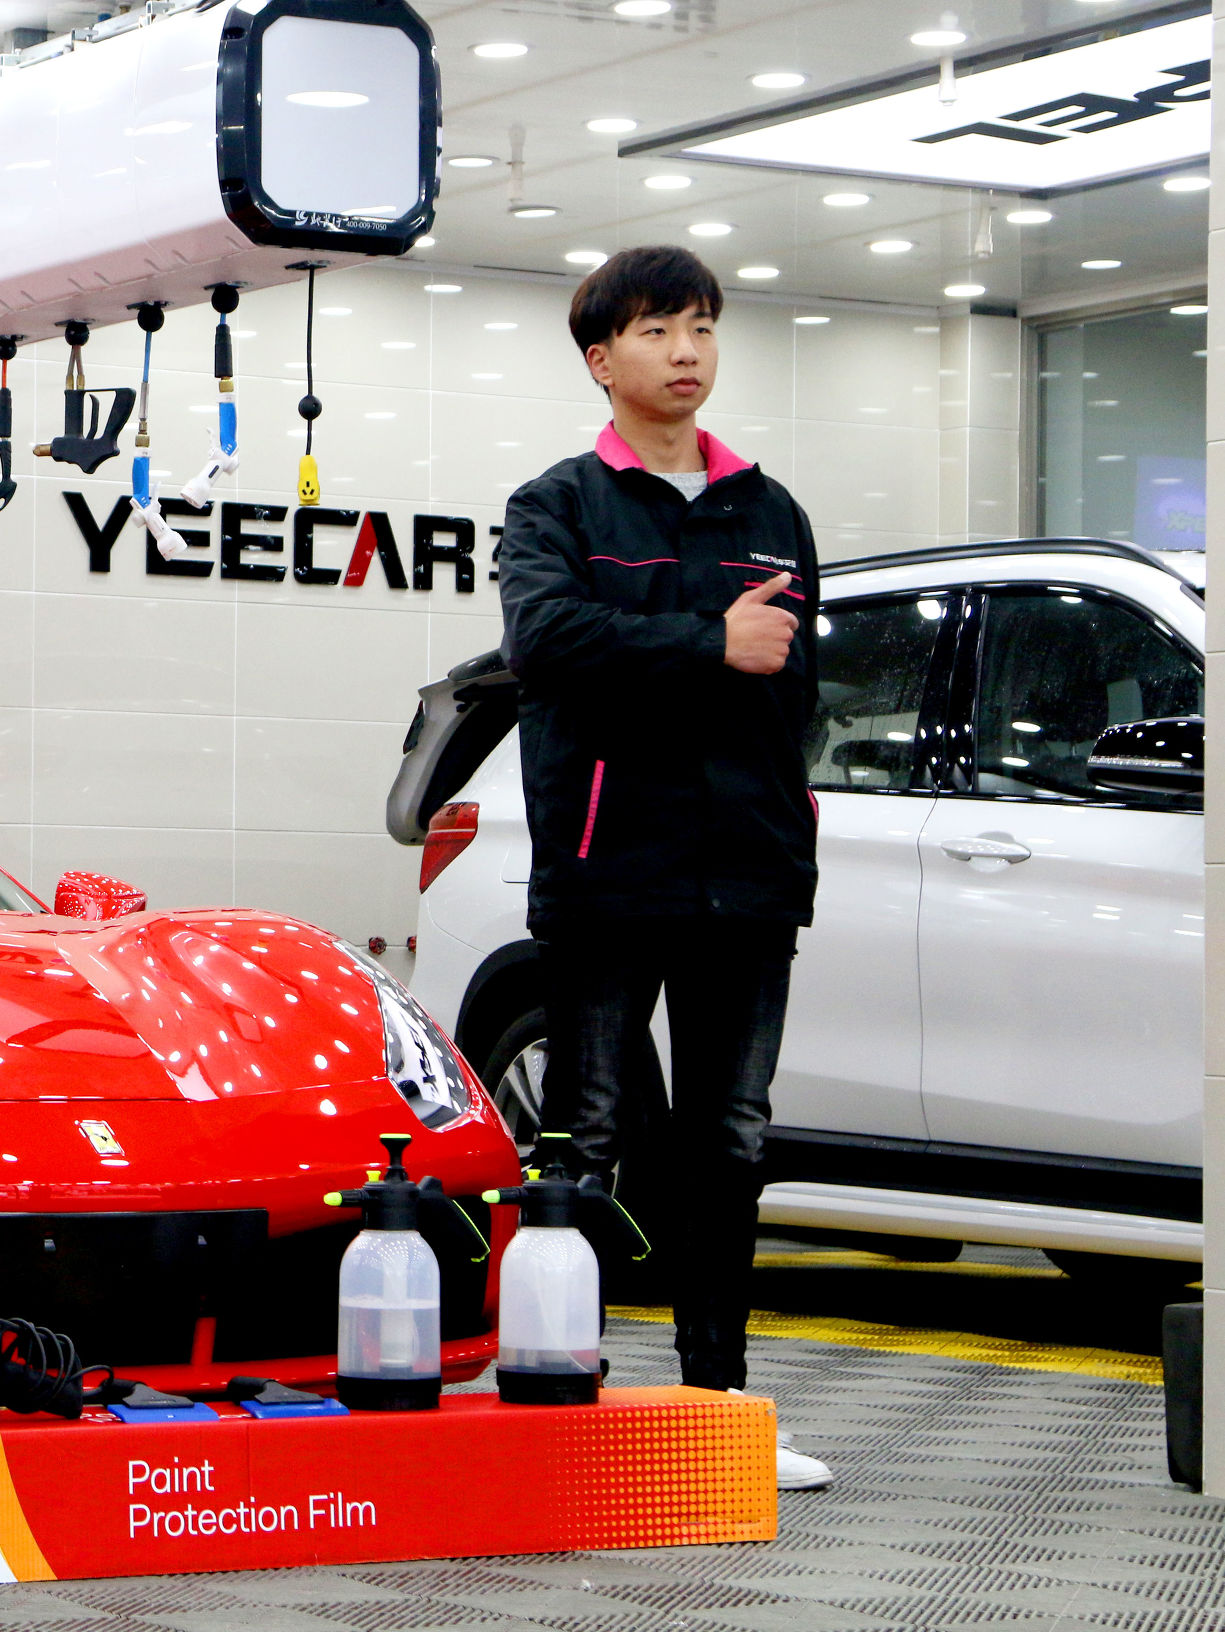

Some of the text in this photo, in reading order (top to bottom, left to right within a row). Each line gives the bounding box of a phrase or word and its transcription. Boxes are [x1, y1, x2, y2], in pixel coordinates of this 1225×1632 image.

[62, 491, 475, 593] YEECAR
[128, 1457, 215, 1495] Paint
[129, 1491, 376, 1538] Protection Film
